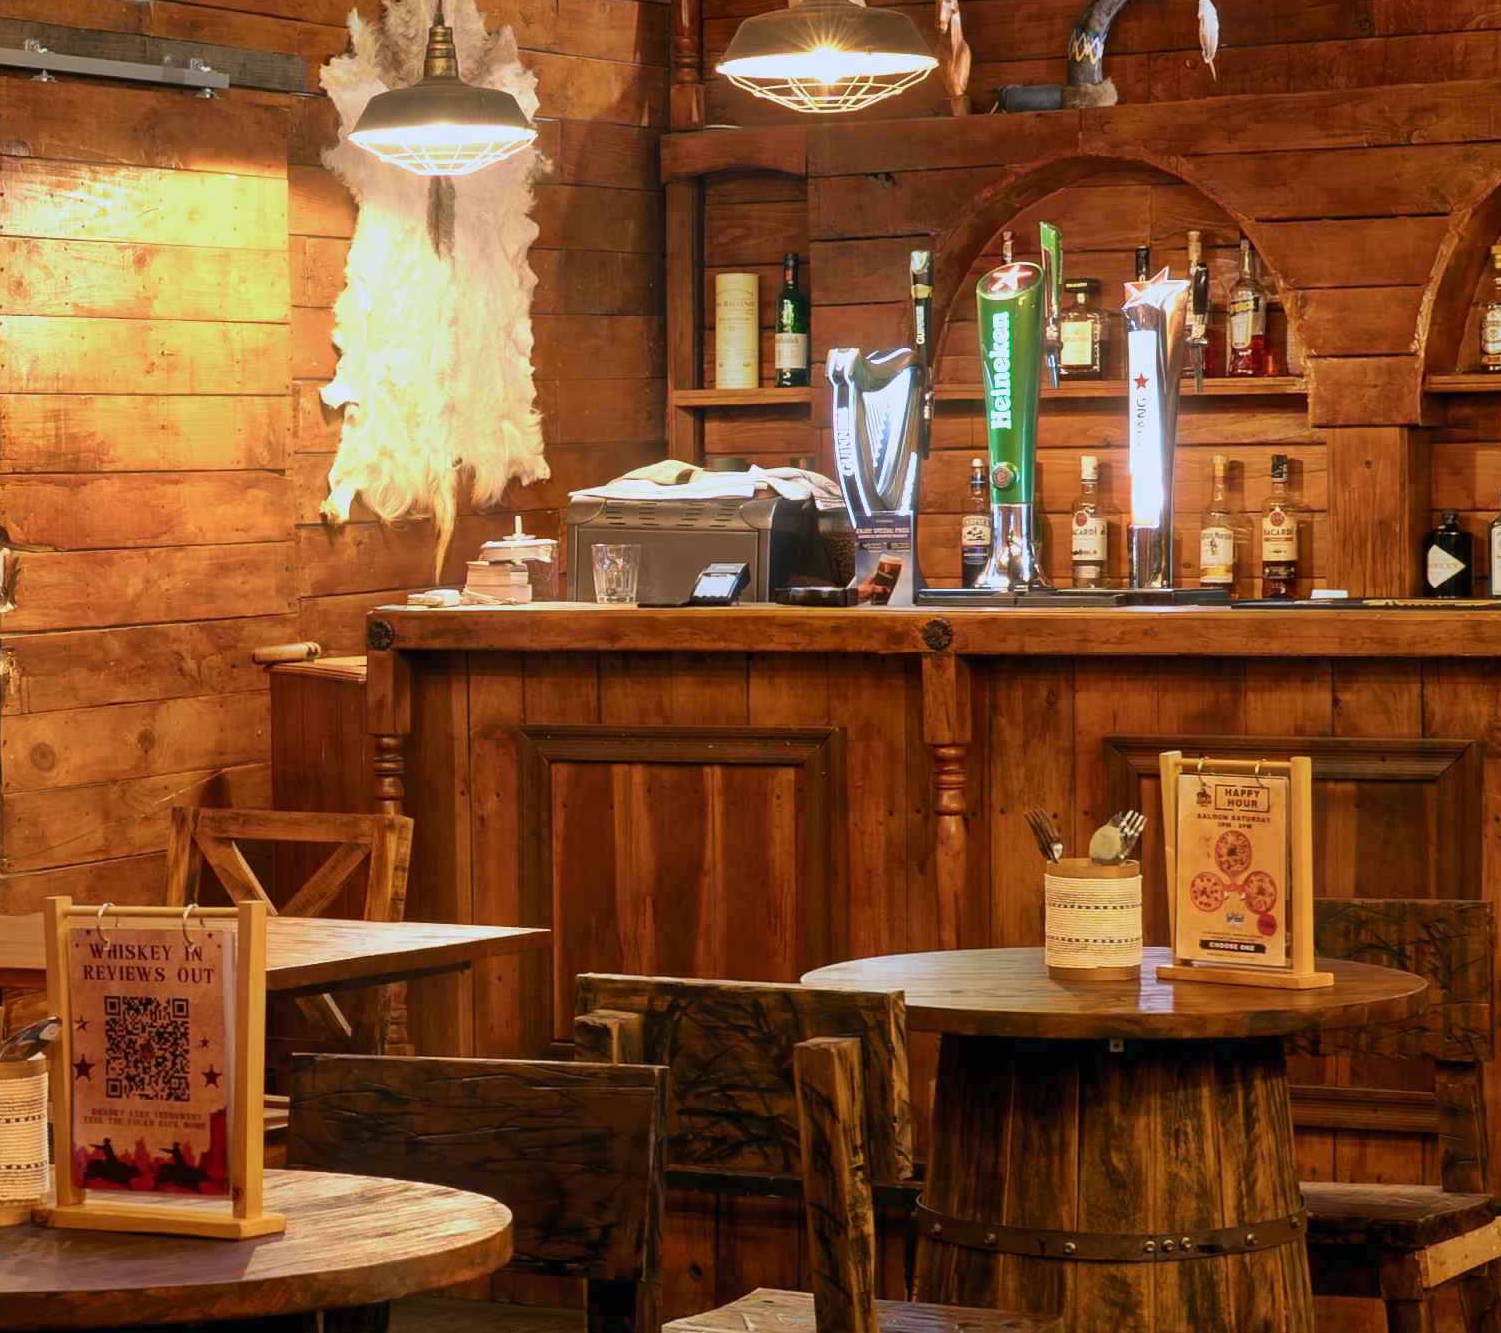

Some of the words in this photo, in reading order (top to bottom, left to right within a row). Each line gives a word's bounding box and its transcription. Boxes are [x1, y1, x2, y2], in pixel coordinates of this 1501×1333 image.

[990, 310, 1012, 429] Heineken
[1225, 789, 1260, 797] HAPPY
[1227, 799, 1257, 807] HOUR
[89, 943, 172, 961] WHISKEY
[184, 946, 203, 962] IN
[83, 965, 165, 982] REVIEWS
[177, 968, 215, 984] OUT
